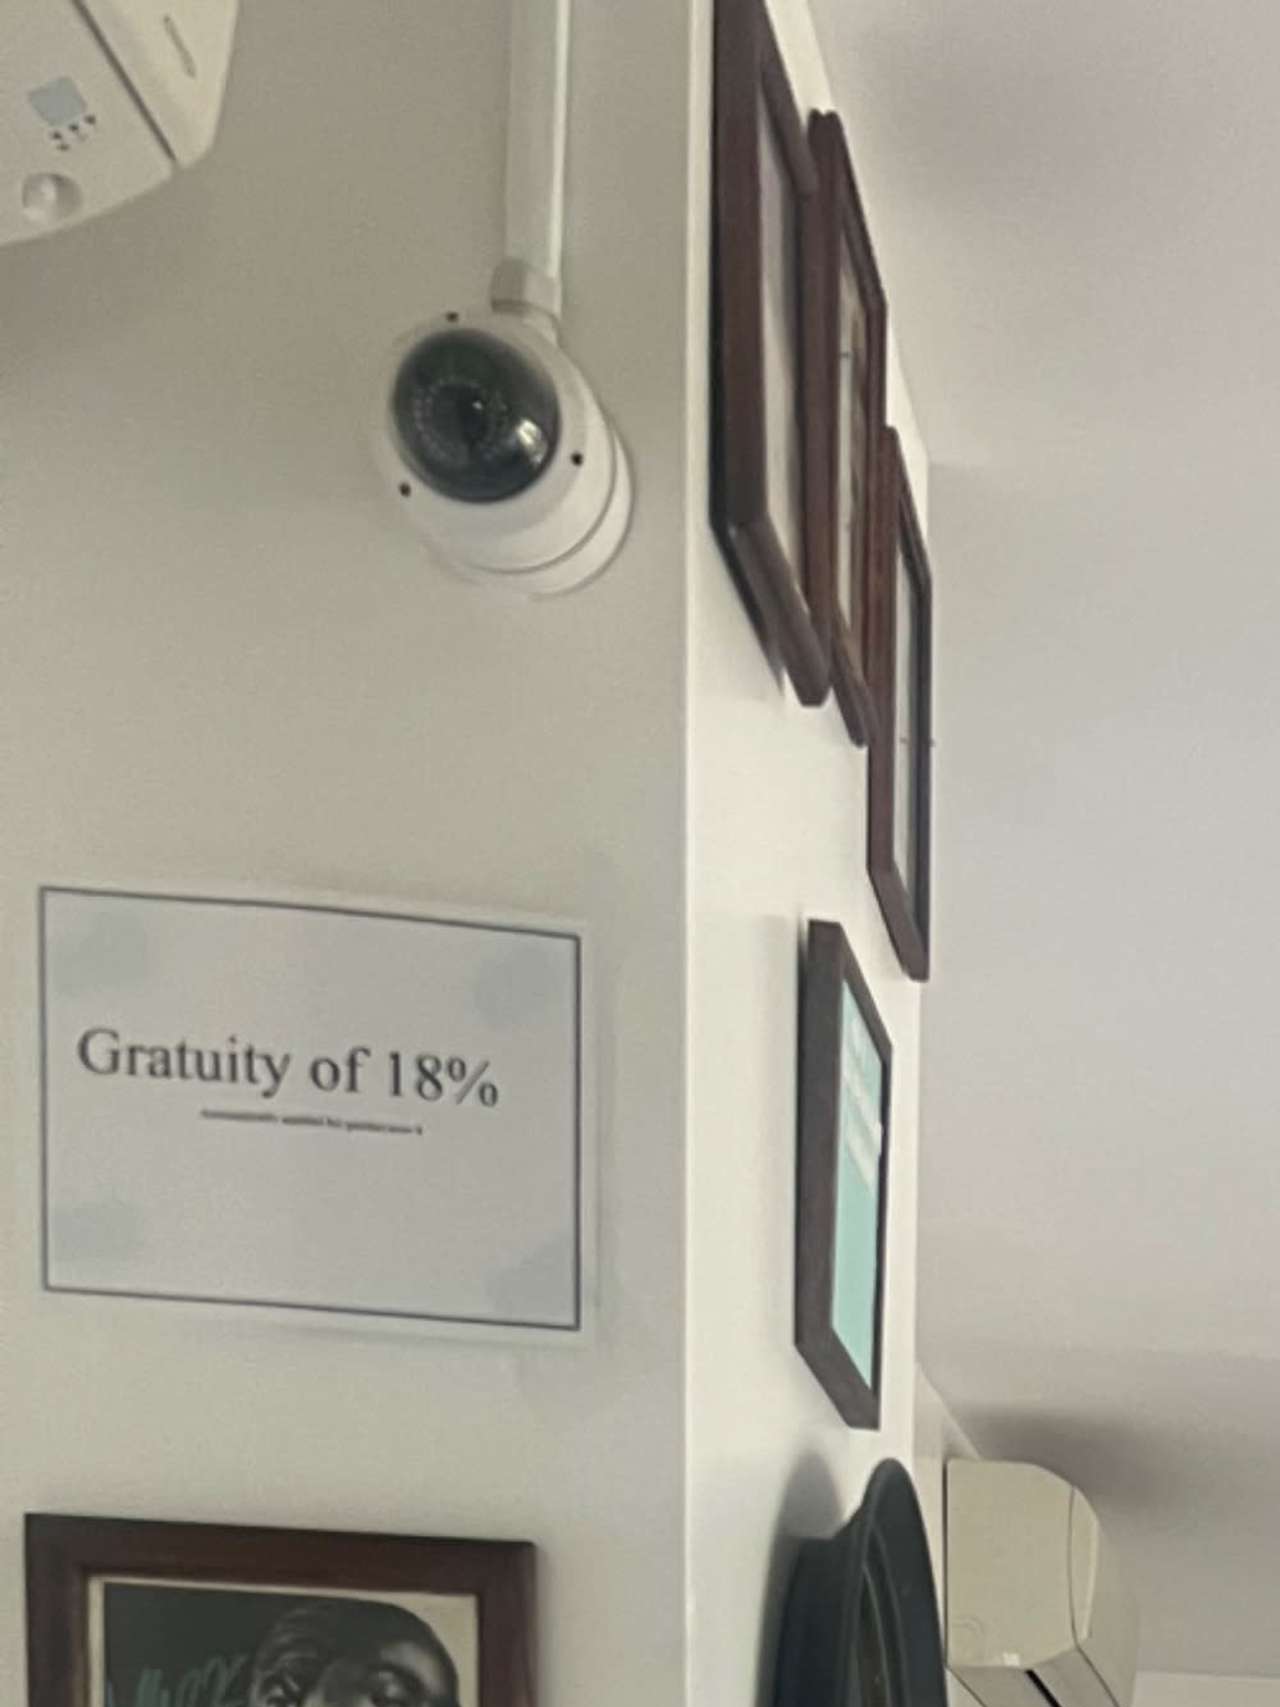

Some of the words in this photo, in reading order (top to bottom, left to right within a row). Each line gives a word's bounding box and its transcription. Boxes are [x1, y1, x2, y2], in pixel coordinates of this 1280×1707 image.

[77, 1027, 291, 1099] Gratuity
[309, 1046, 371, 1094] of
[389, 1051, 499, 1108] 18%
